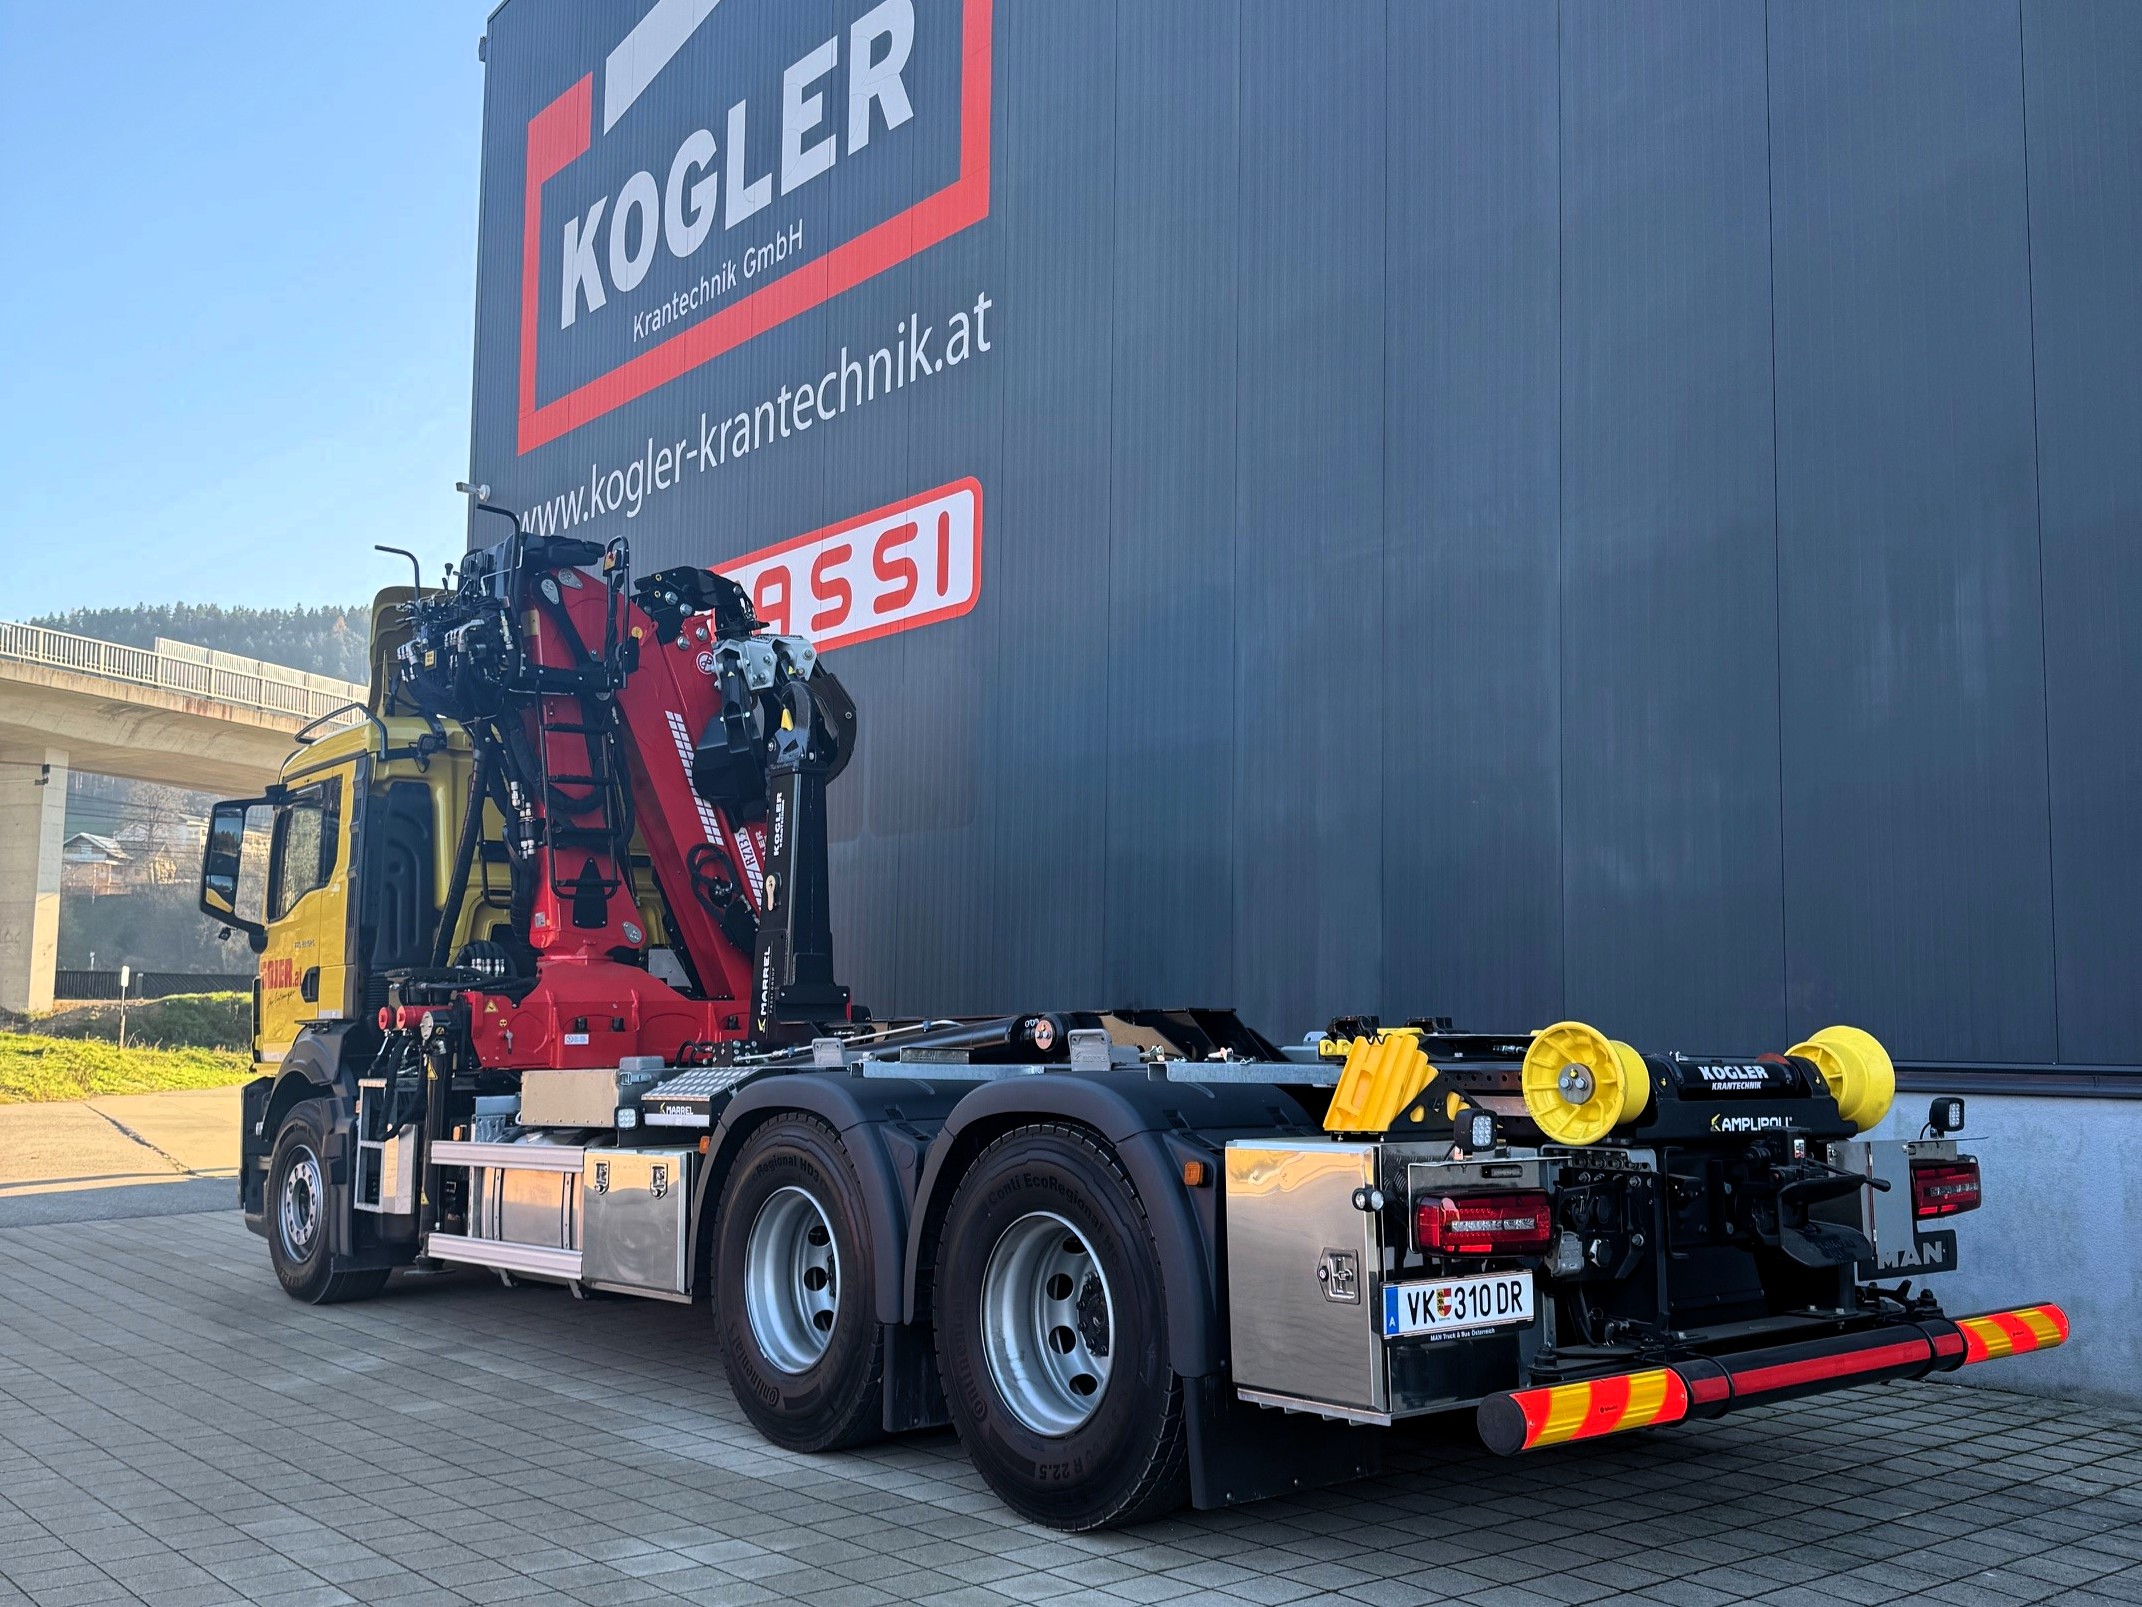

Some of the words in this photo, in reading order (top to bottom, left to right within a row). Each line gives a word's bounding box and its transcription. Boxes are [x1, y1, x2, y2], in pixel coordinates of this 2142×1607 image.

[561, 0, 916, 330] KOGLER
[633, 259, 737, 343] Krantechnik
[743, 218, 803, 279] GmbH
[516, 291, 993, 537] www.kogler-krantechnik.at
[753, 510, 950, 637] ASSI
[773, 792, 783, 857] KOGLER
[760, 946, 771, 1016] MARREL
[1698, 1065, 1769, 1080] KOGLER
[1711, 1081, 1762, 1091] KRANTECHNIK
[666, 1105, 694, 1116] MARREL
[1877, 1241, 1943, 1270] MAN
[1388, 1316, 1397, 1327] A
[1407, 1289, 1437, 1326] VK
[1454, 1286, 1492, 1320] 310
[1496, 1280, 1523, 1315] DR
[1430, 1334, 1442, 1342] MAN
[1443, 1332, 1456, 1340] Truck
